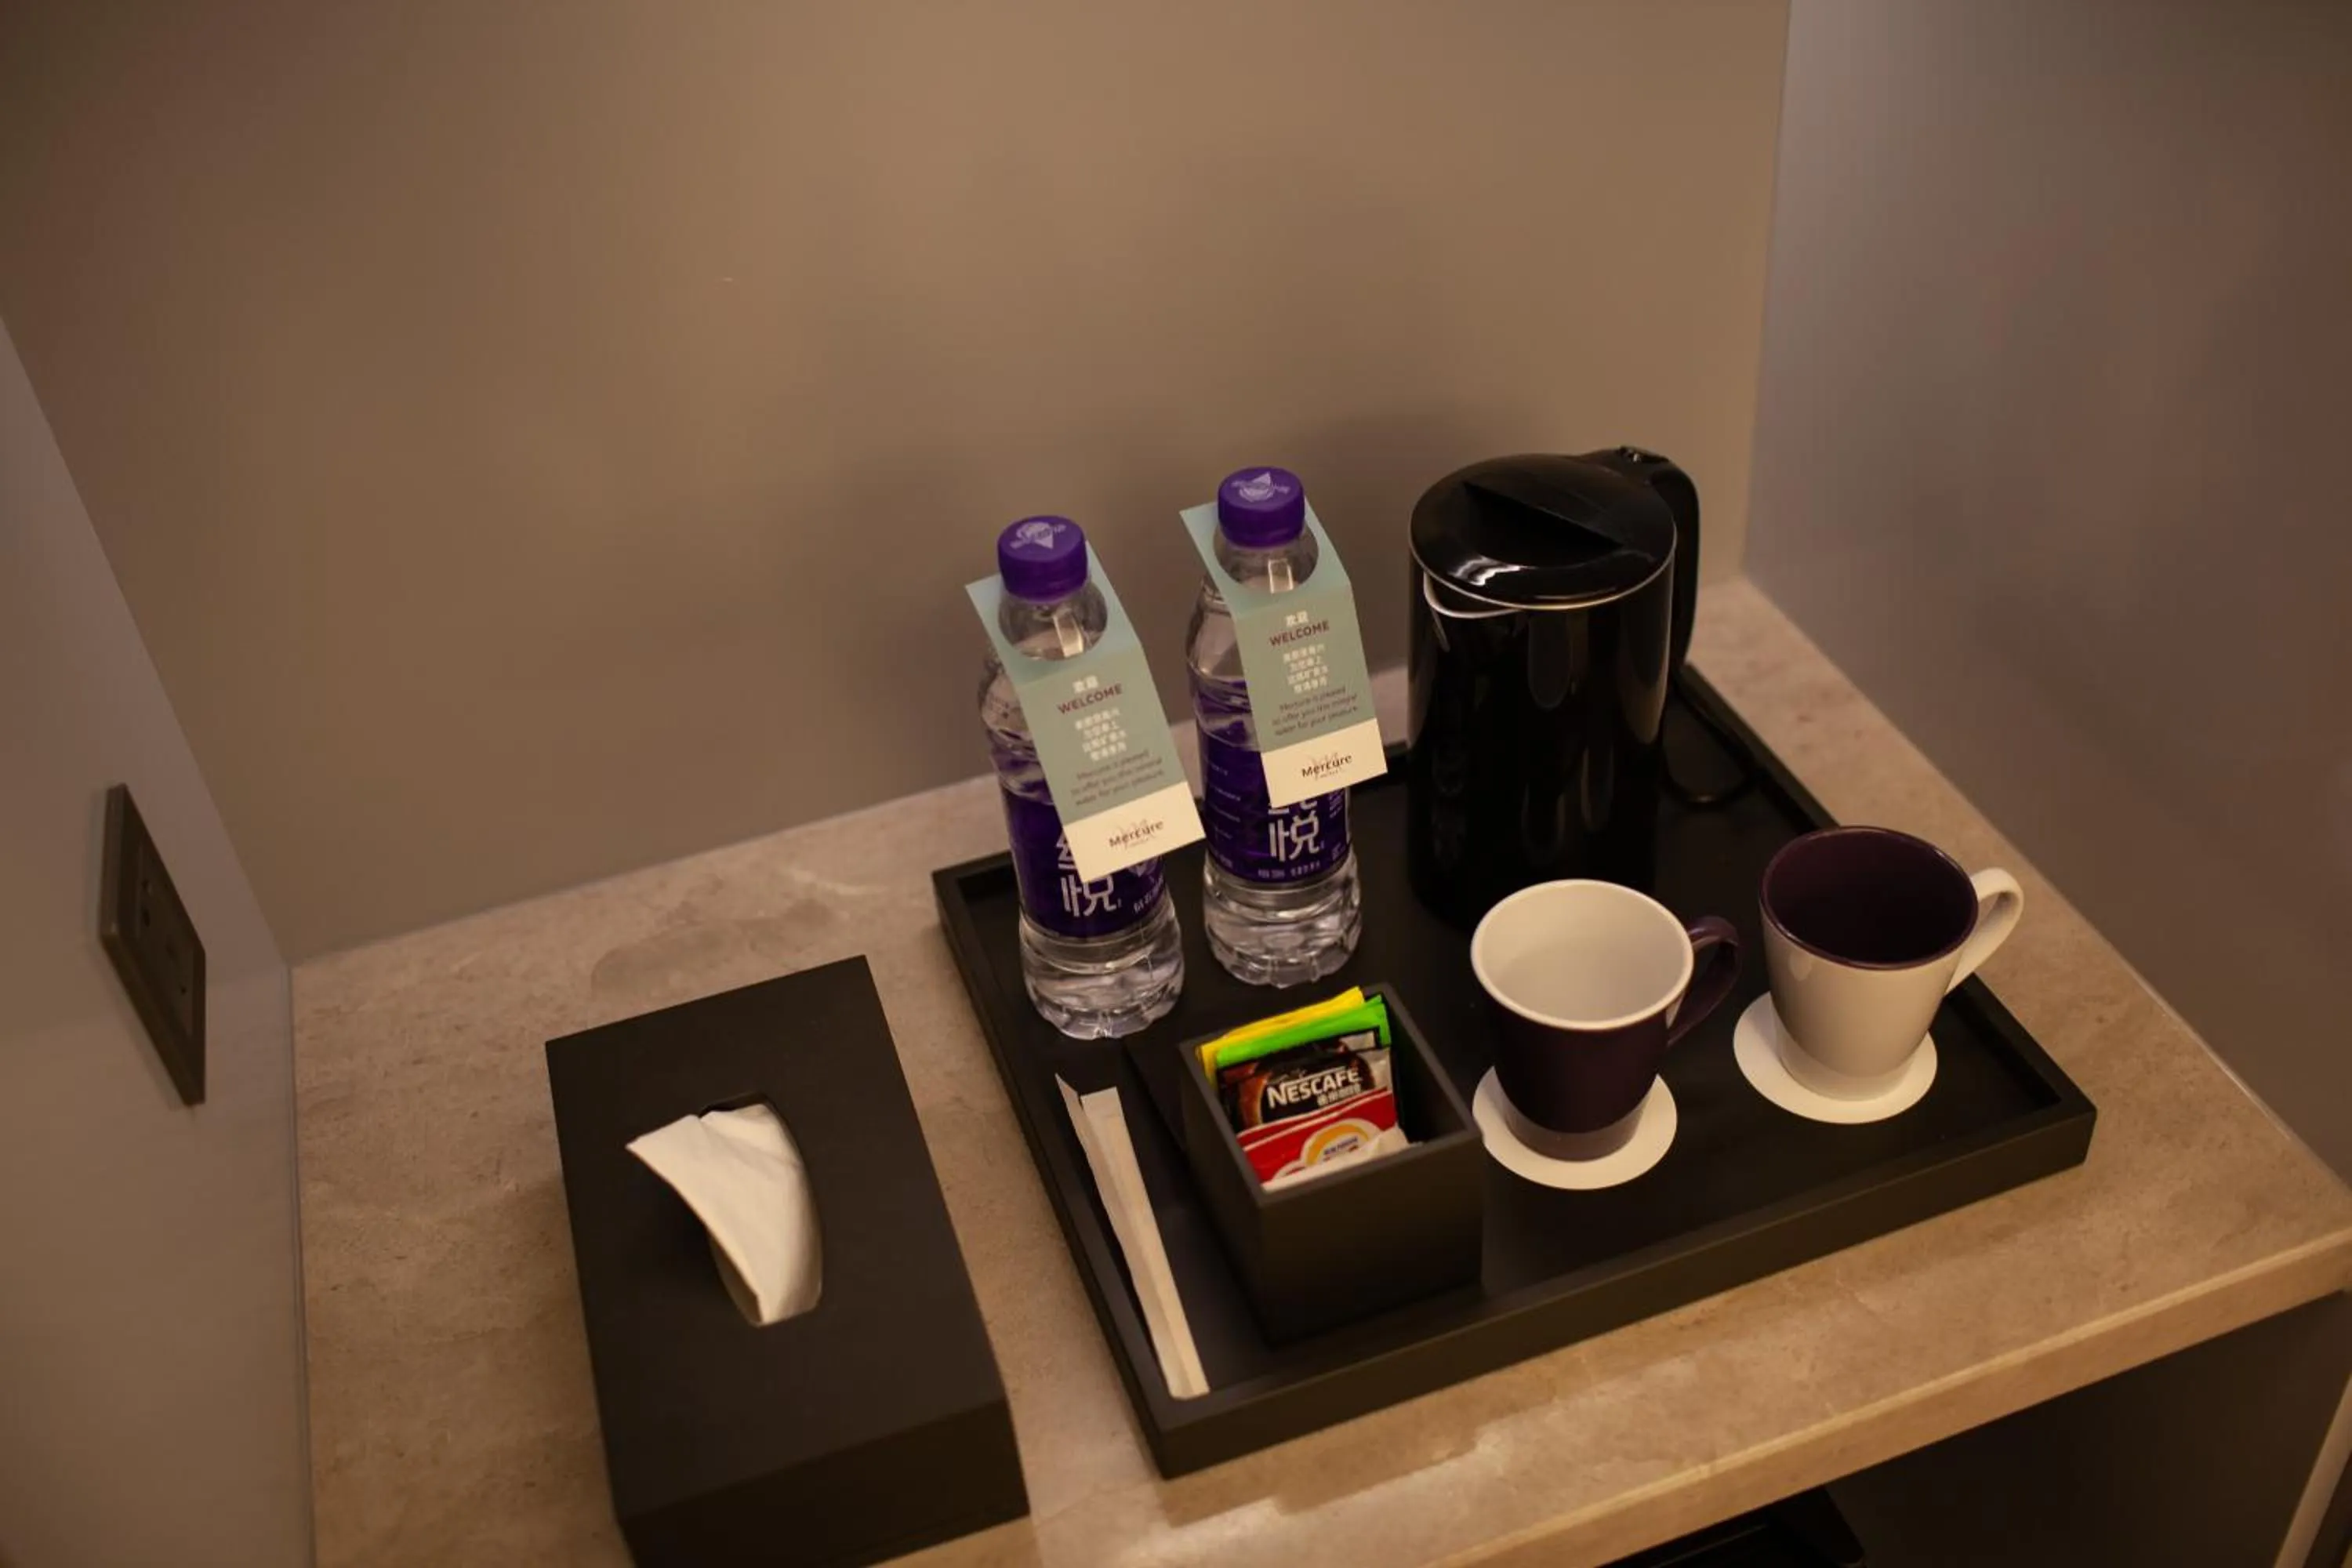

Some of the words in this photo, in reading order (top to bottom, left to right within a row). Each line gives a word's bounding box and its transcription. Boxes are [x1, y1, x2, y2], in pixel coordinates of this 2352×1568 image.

[1269, 620, 1330, 646] WELCOME
[1058, 683, 1123, 714] WELCOME
[1301, 753, 1352, 778] Mercure
[1109, 820, 1164, 848] Mercure
[1268, 797, 1320, 862] 悦
